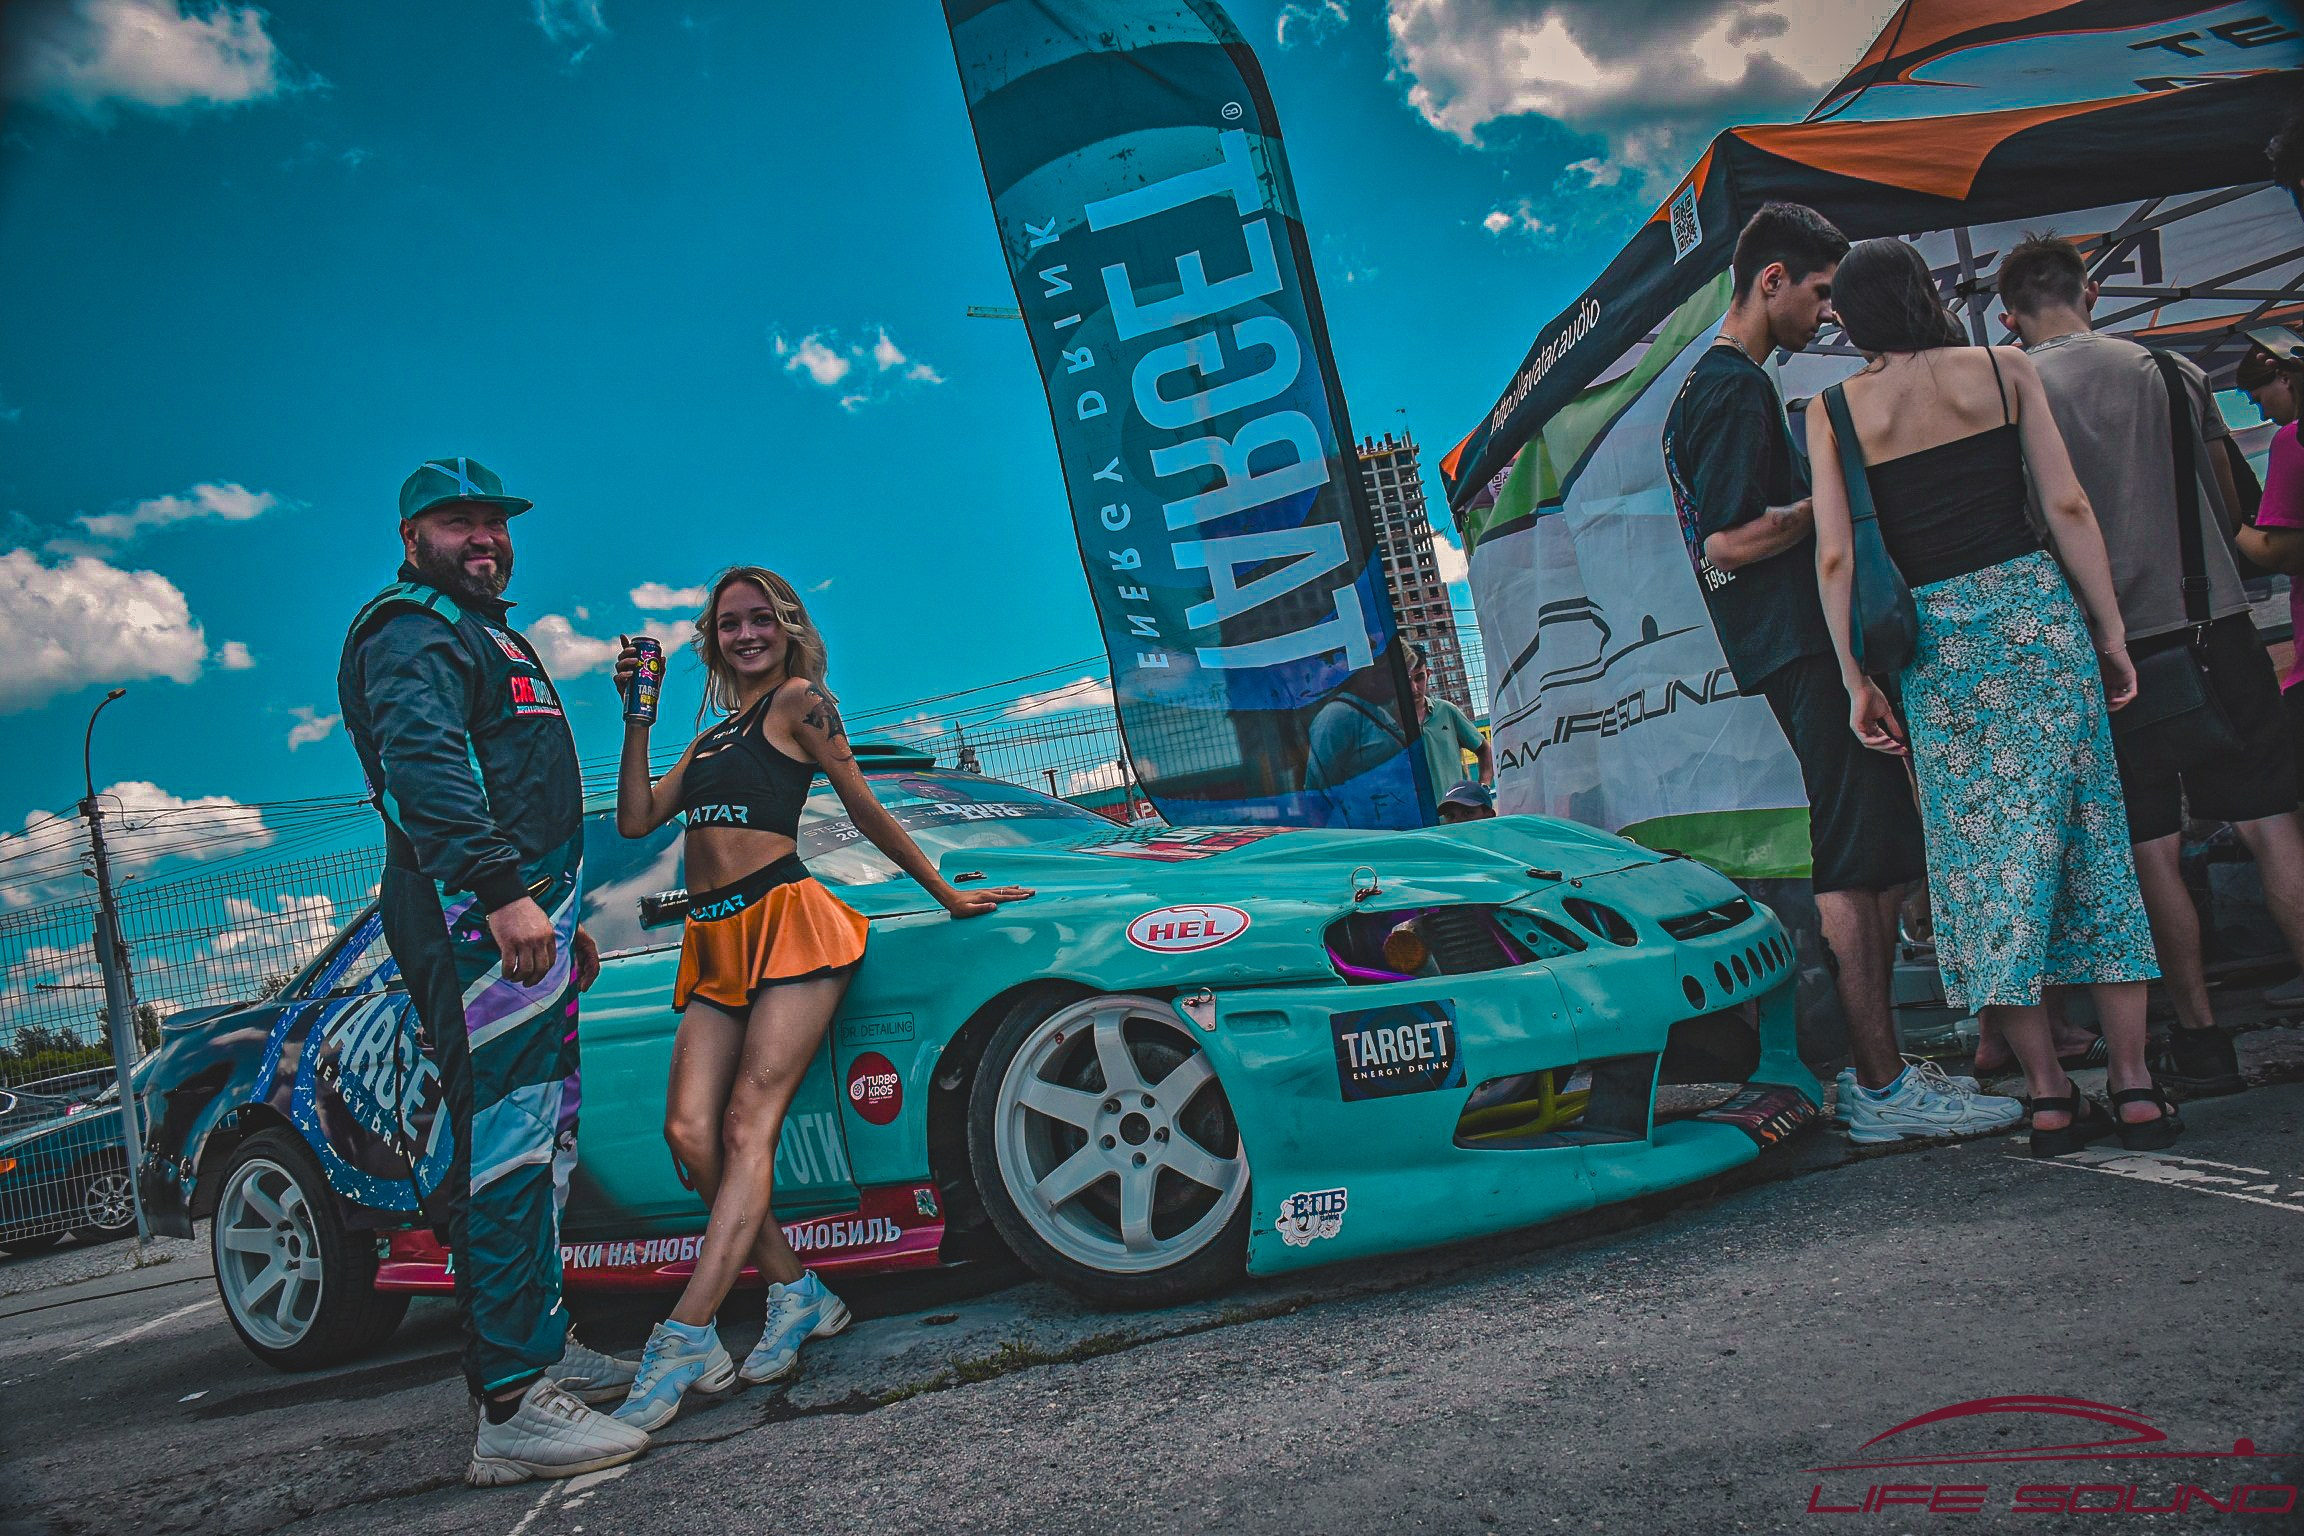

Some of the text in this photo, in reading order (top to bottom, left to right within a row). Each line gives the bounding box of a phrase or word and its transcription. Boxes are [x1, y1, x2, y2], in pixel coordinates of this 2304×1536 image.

[2126, 15, 2302, 59] TE
[688, 804, 748, 825] ATAR
[803, 821, 850, 838] STRO
[836, 830, 860, 842] 20
[1147, 920, 1225, 942] HEL
[860, 1020, 914, 1037] DETAILING
[1341, 1020, 1451, 1068] TARGET
[322, 973, 448, 1159] TARGET
[1353, 1060, 1449, 1081] ENERGY DRINK
[306, 1044, 365, 1114] ENERGY
[866, 1073, 898, 1087] TURBO
[868, 1084, 894, 1098] KROS
[560, 1245, 603, 1270] РКИ
[607, 1242, 637, 1267] НА
[641, 1236, 705, 1265] ЛЮБО
